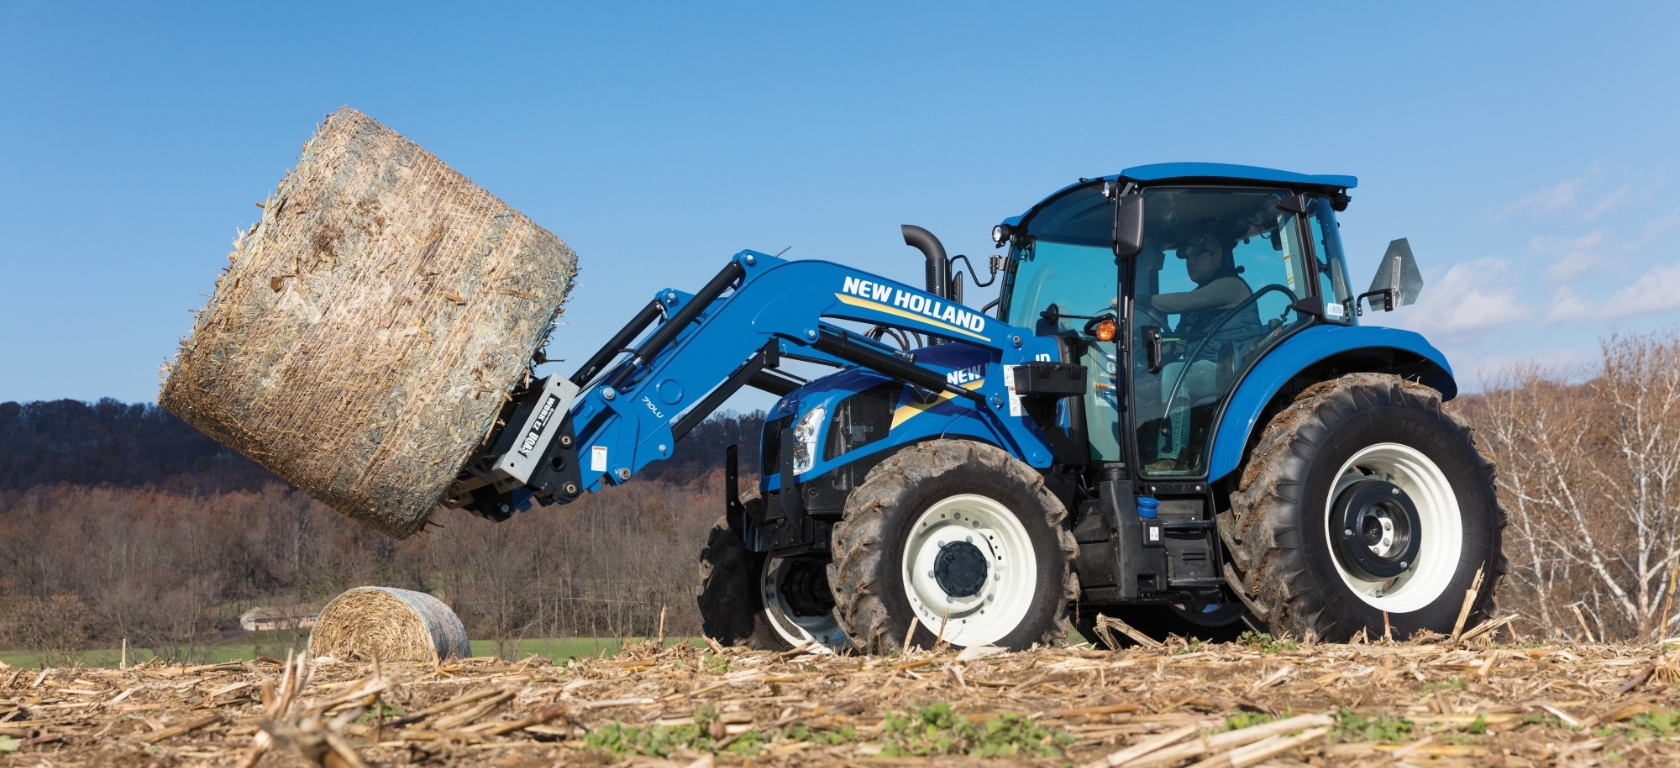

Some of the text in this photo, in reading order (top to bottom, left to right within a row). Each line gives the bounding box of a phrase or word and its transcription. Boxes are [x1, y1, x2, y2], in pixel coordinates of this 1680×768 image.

[842, 276, 985, 333] NEW HOLLAND
[946, 364, 982, 386] NEW
[538, 397, 555, 420] WORK
